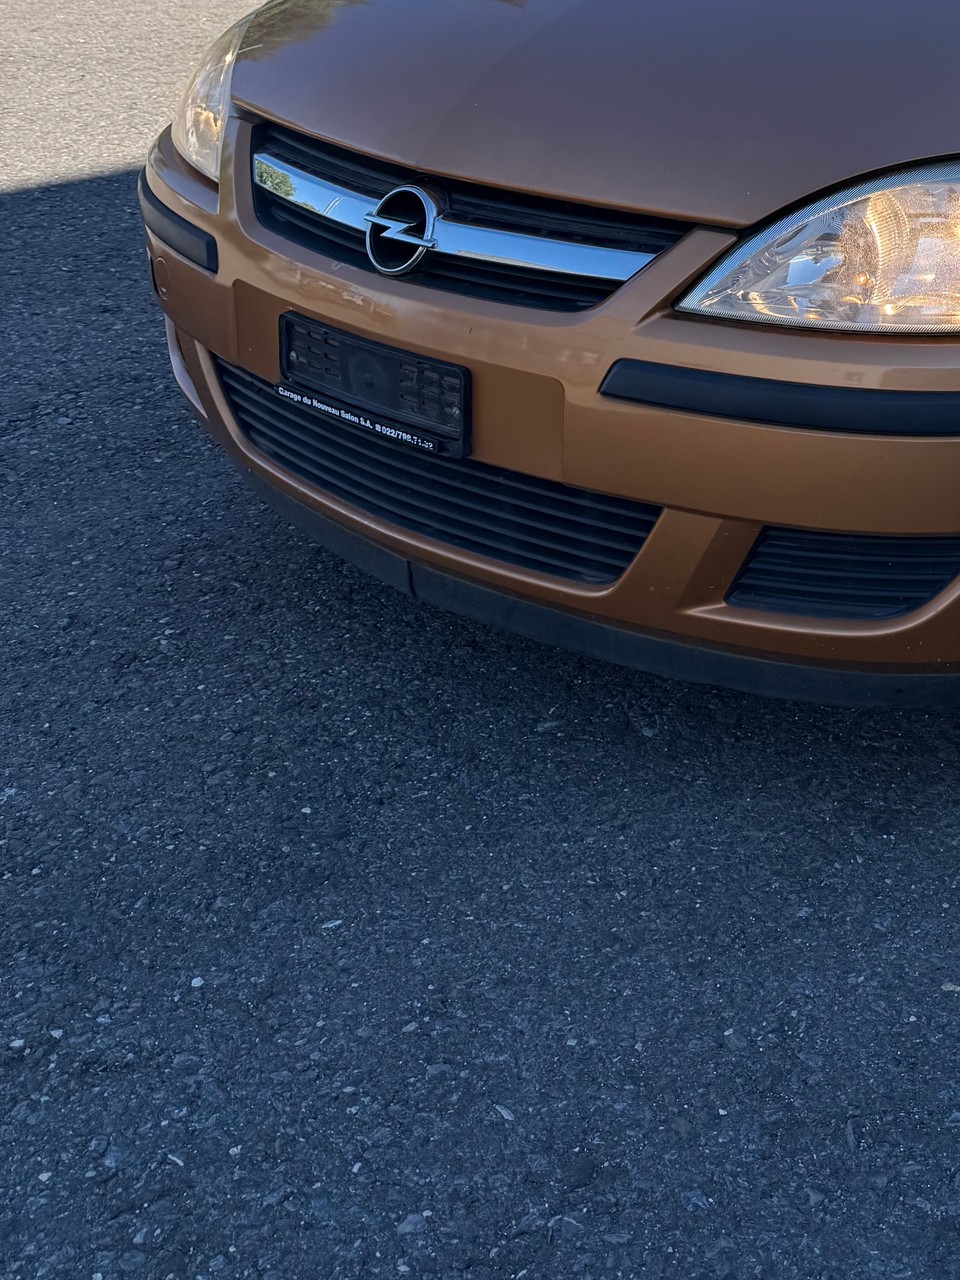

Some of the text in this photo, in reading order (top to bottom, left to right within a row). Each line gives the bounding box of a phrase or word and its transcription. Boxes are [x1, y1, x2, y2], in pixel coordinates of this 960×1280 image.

[278, 386, 302, 401] Garage
[303, 396, 311, 405] du
[312, 398, 339, 415] Nouveau
[340, 410, 359, 423] Salon
[360, 417, 373, 428] S.A.
